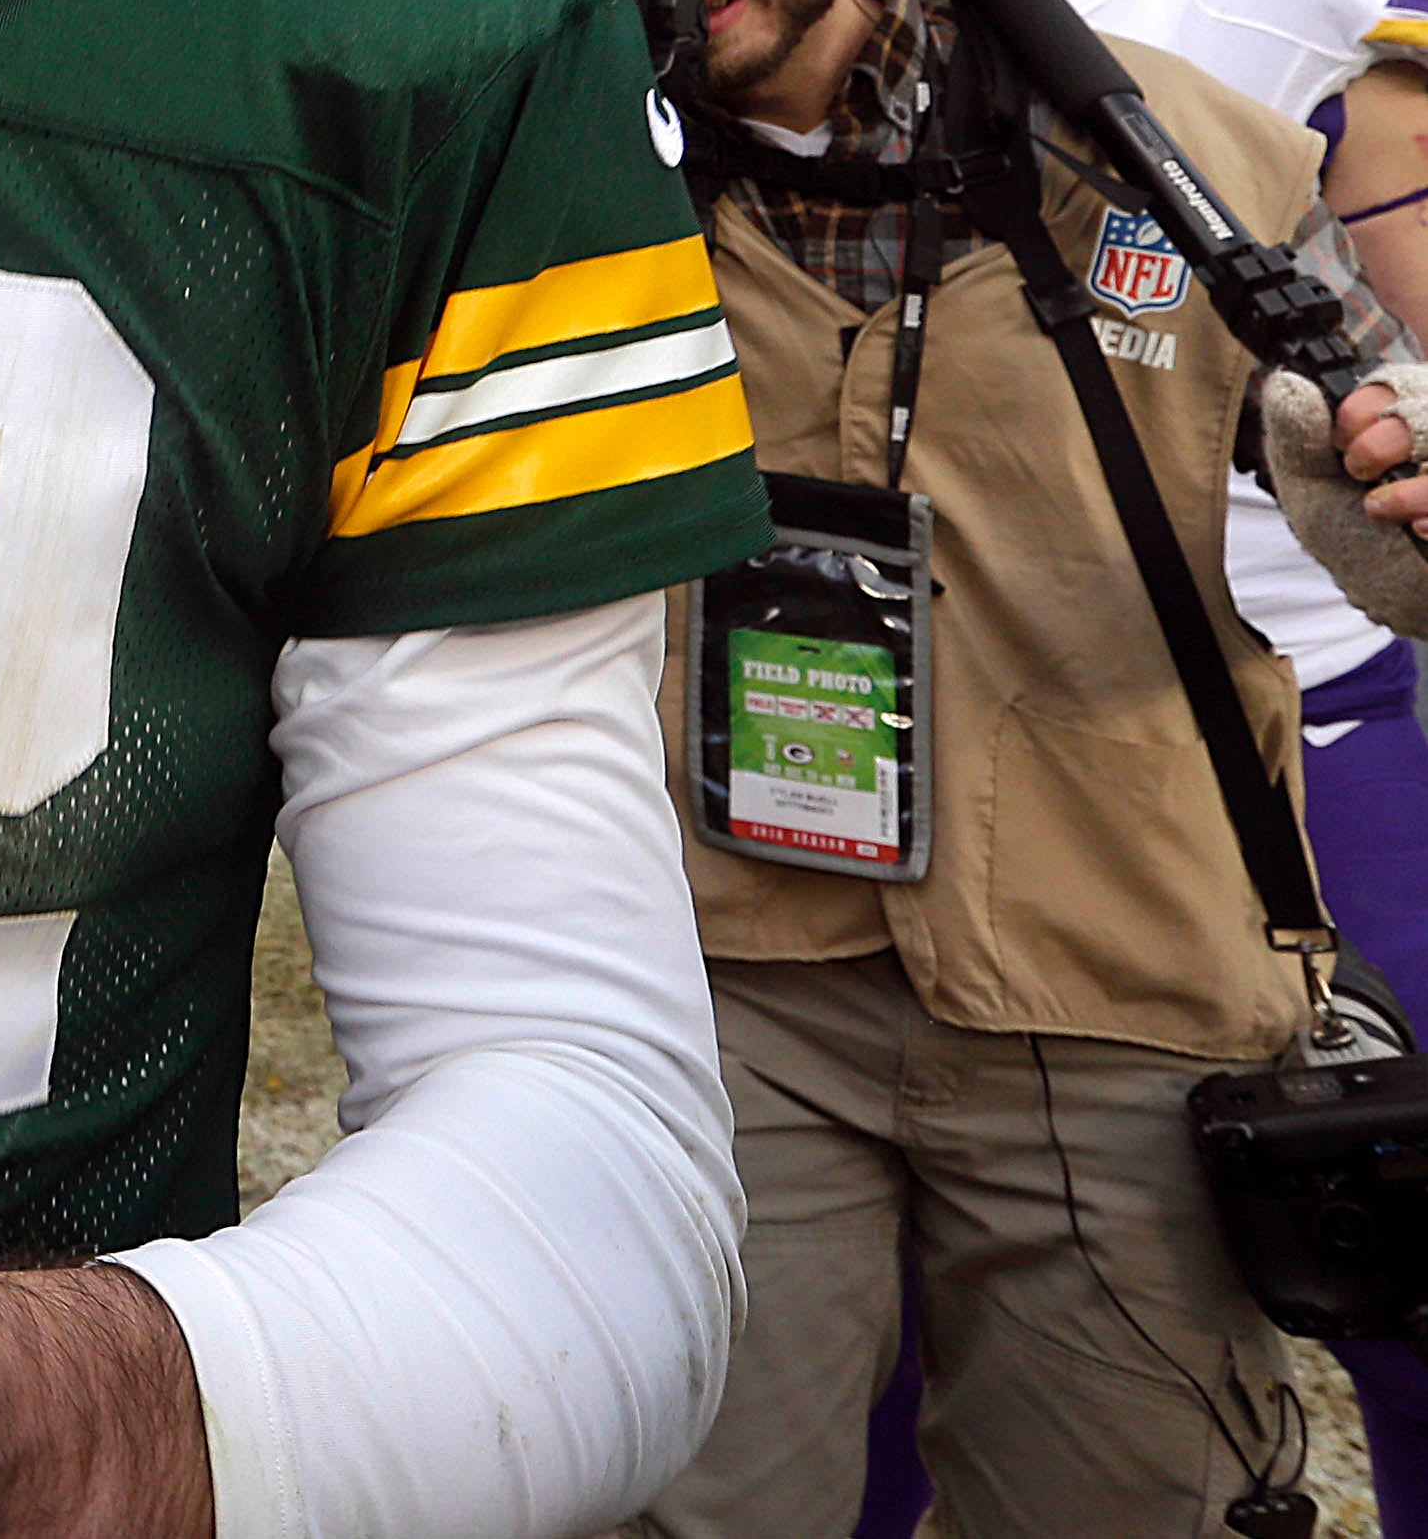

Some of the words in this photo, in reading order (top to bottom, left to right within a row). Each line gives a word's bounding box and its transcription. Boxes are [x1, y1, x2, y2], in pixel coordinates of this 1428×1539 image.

[1162, 159, 1235, 240] Manfrotto
[1099, 247, 1174, 302] NFL
[1089, 316, 1177, 370] EDIA
[743, 661, 801, 685] FIELD
[807, 669, 873, 695] PHOTO
